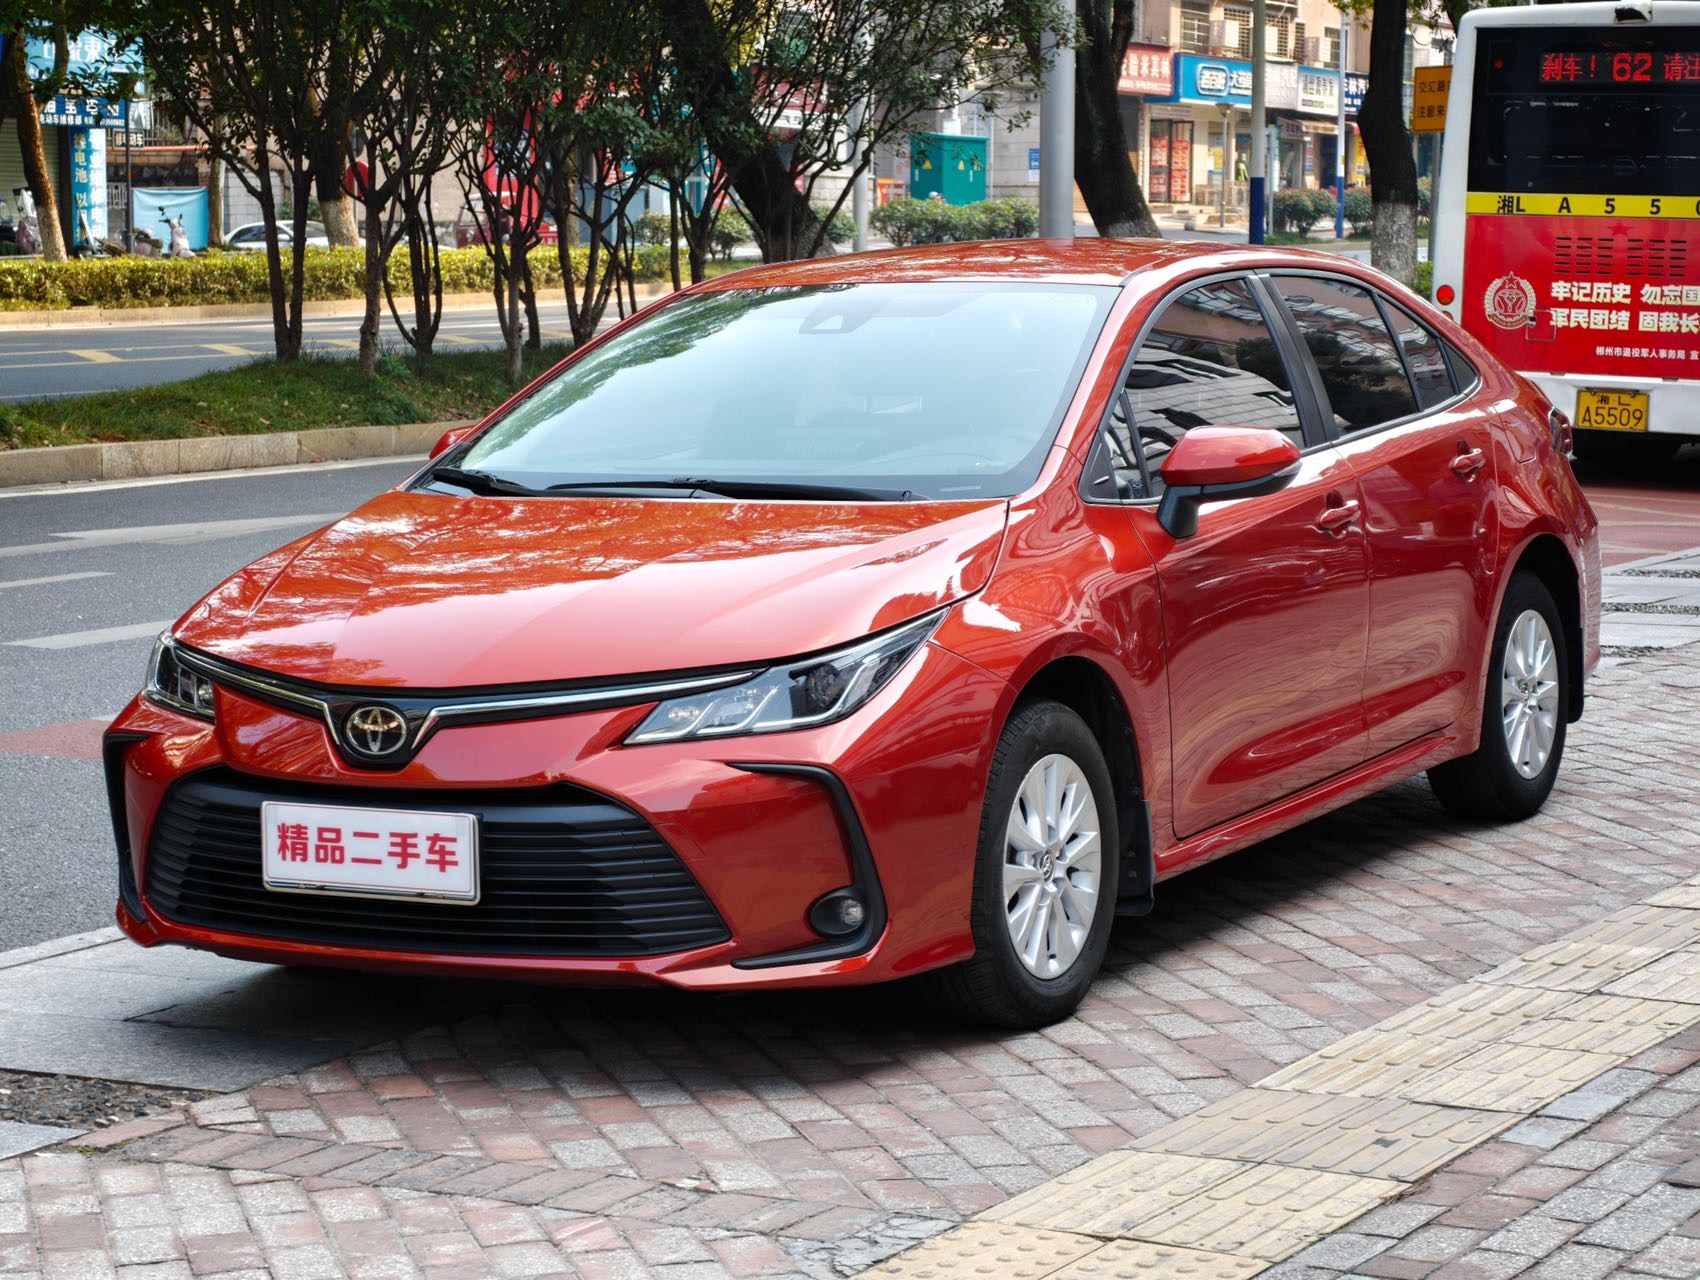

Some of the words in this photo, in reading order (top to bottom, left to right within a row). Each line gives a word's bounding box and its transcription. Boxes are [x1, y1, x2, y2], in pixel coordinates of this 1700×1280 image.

[1613, 52, 1652, 82] 62
[1418, 80, 1450, 94] 交汇路
[1557, 197, 1571, 213] A
[1604, 198, 1616, 214] 5
[1649, 198, 1661, 215] 5
[1551, 280, 1631, 304] 牢记历史
[1641, 284, 1700, 306] 勿忘国
[1550, 307, 1630, 331] 军民团结
[1595, 346, 1685, 360] 郴州市退役军人事务局
[1581, 406, 1643, 427] A5509
[277, 822, 459, 873] 精品二手车
